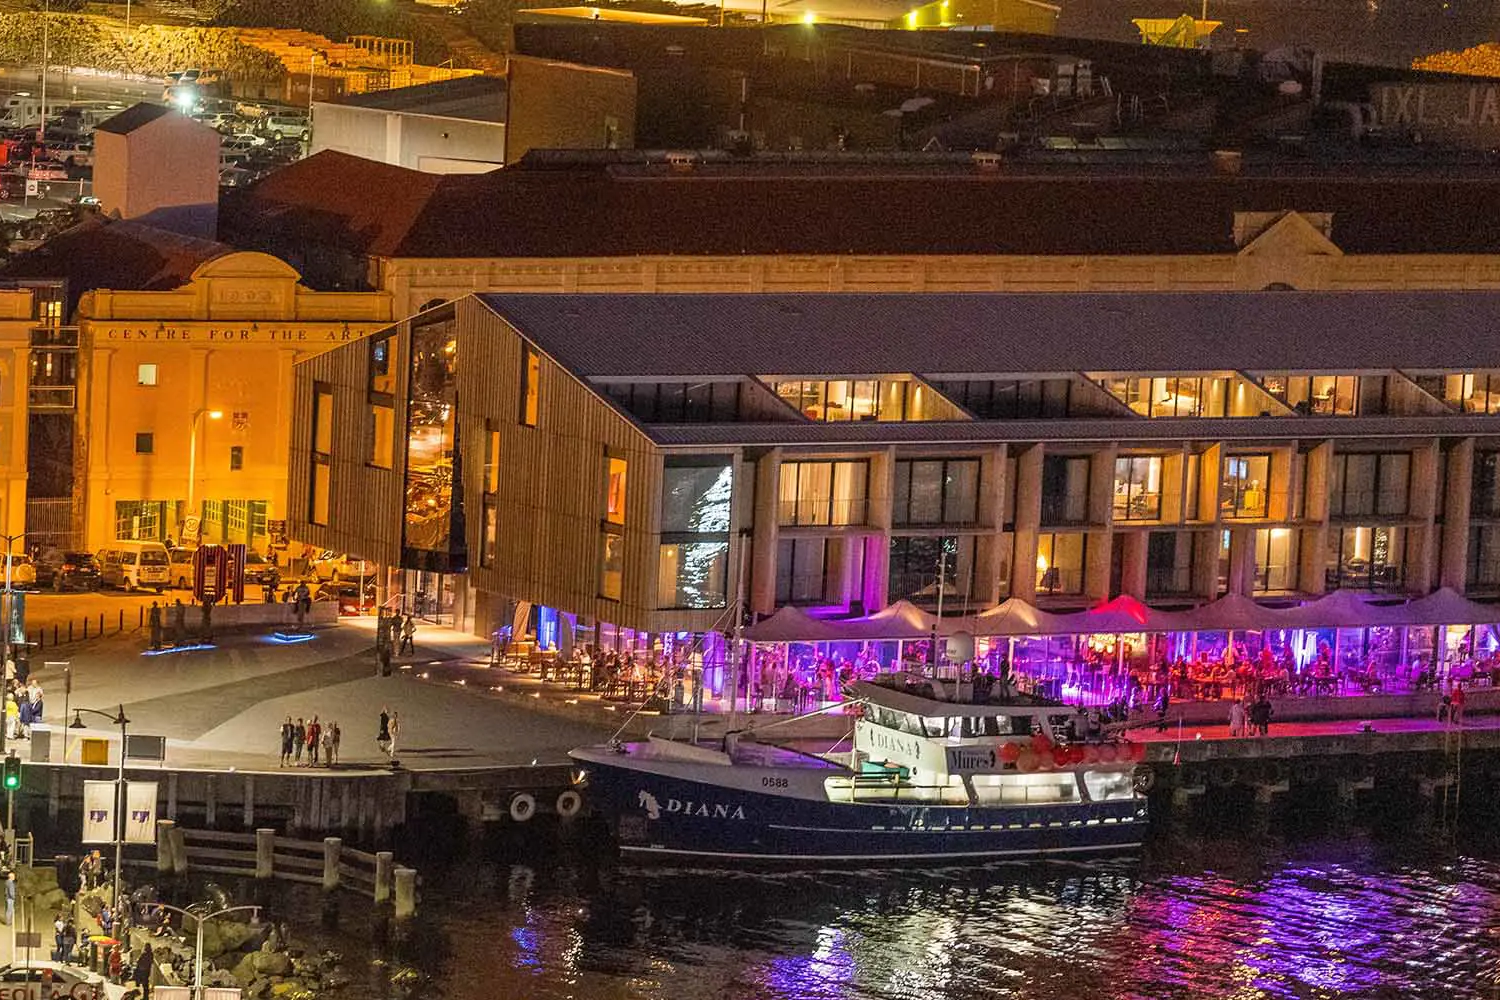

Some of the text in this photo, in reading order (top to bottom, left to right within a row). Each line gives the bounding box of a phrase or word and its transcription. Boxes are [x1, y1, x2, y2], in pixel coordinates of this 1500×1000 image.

[108, 329, 191, 341] CENTRE
[209, 329, 250, 341] FOR
[270, 329, 308, 341] THE
[951, 750, 990, 769] Mures
[762, 777, 789, 788] 0588
[667, 798, 746, 820] DIANA
